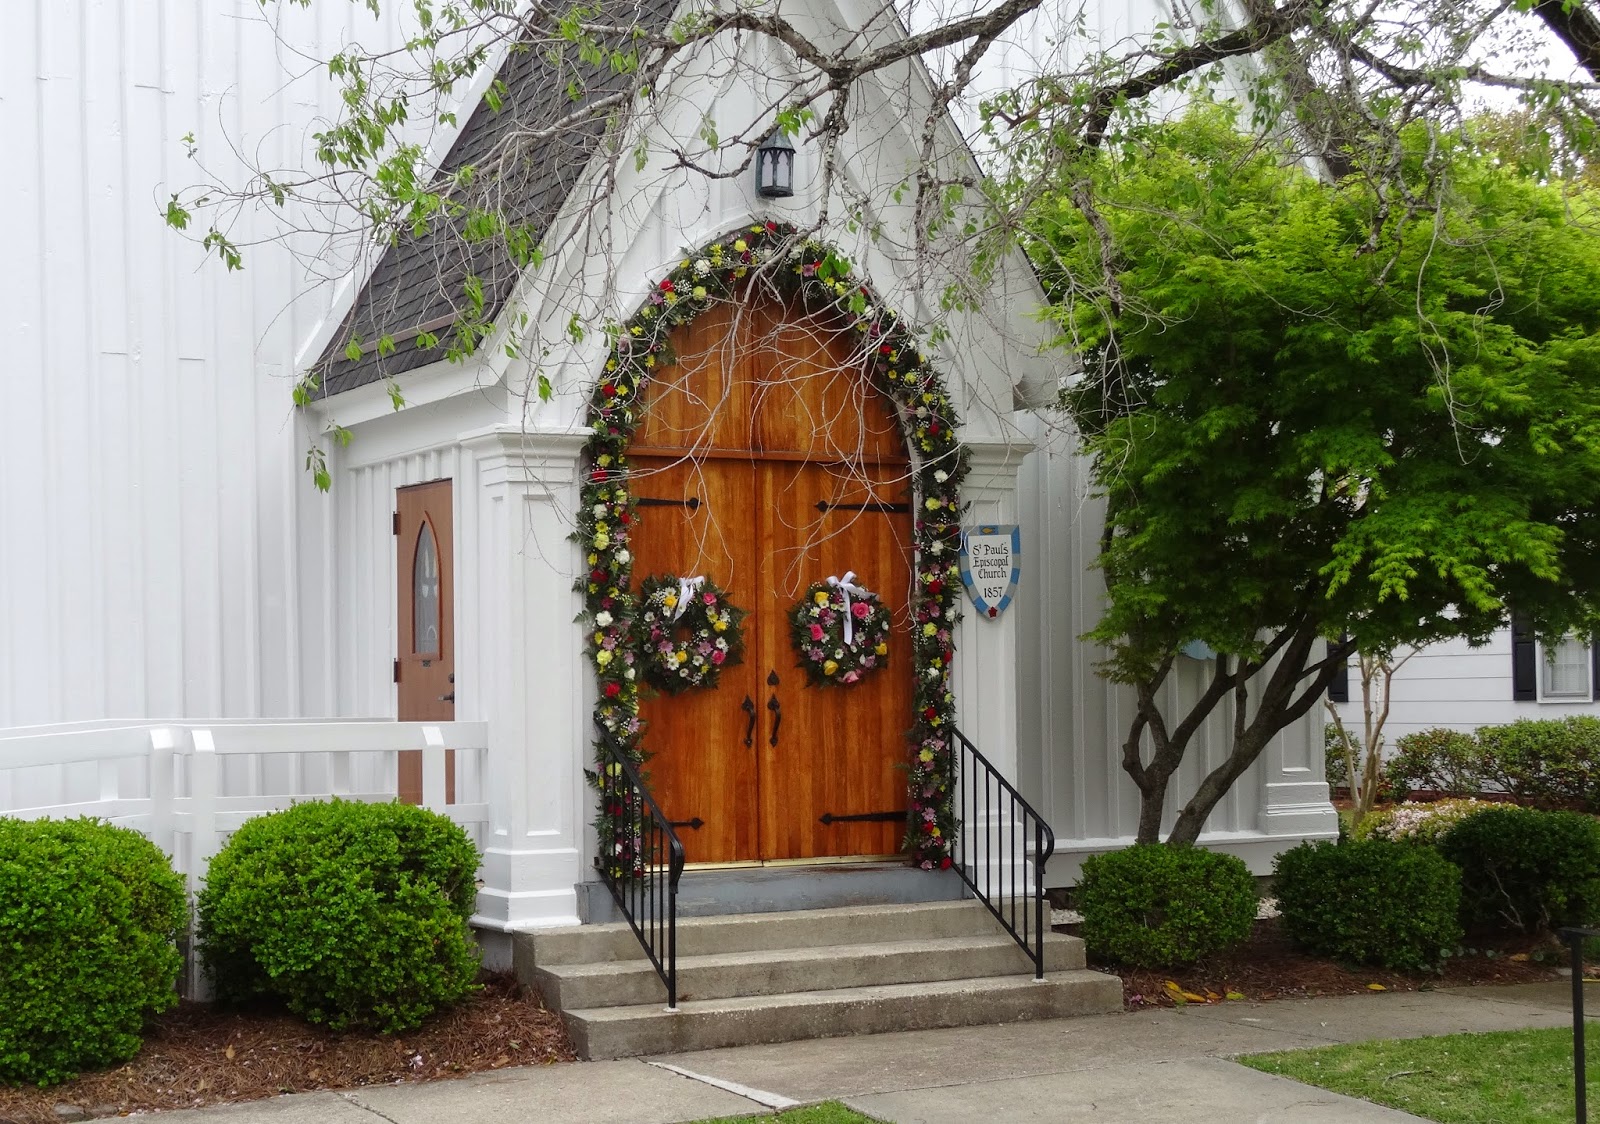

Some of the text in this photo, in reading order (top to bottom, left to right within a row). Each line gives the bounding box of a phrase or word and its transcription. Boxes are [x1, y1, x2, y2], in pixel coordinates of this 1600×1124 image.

[973, 556, 1008, 568] Episcopal
[978, 567, 1007, 579] Church
[984, 587, 1003, 598] 1857
